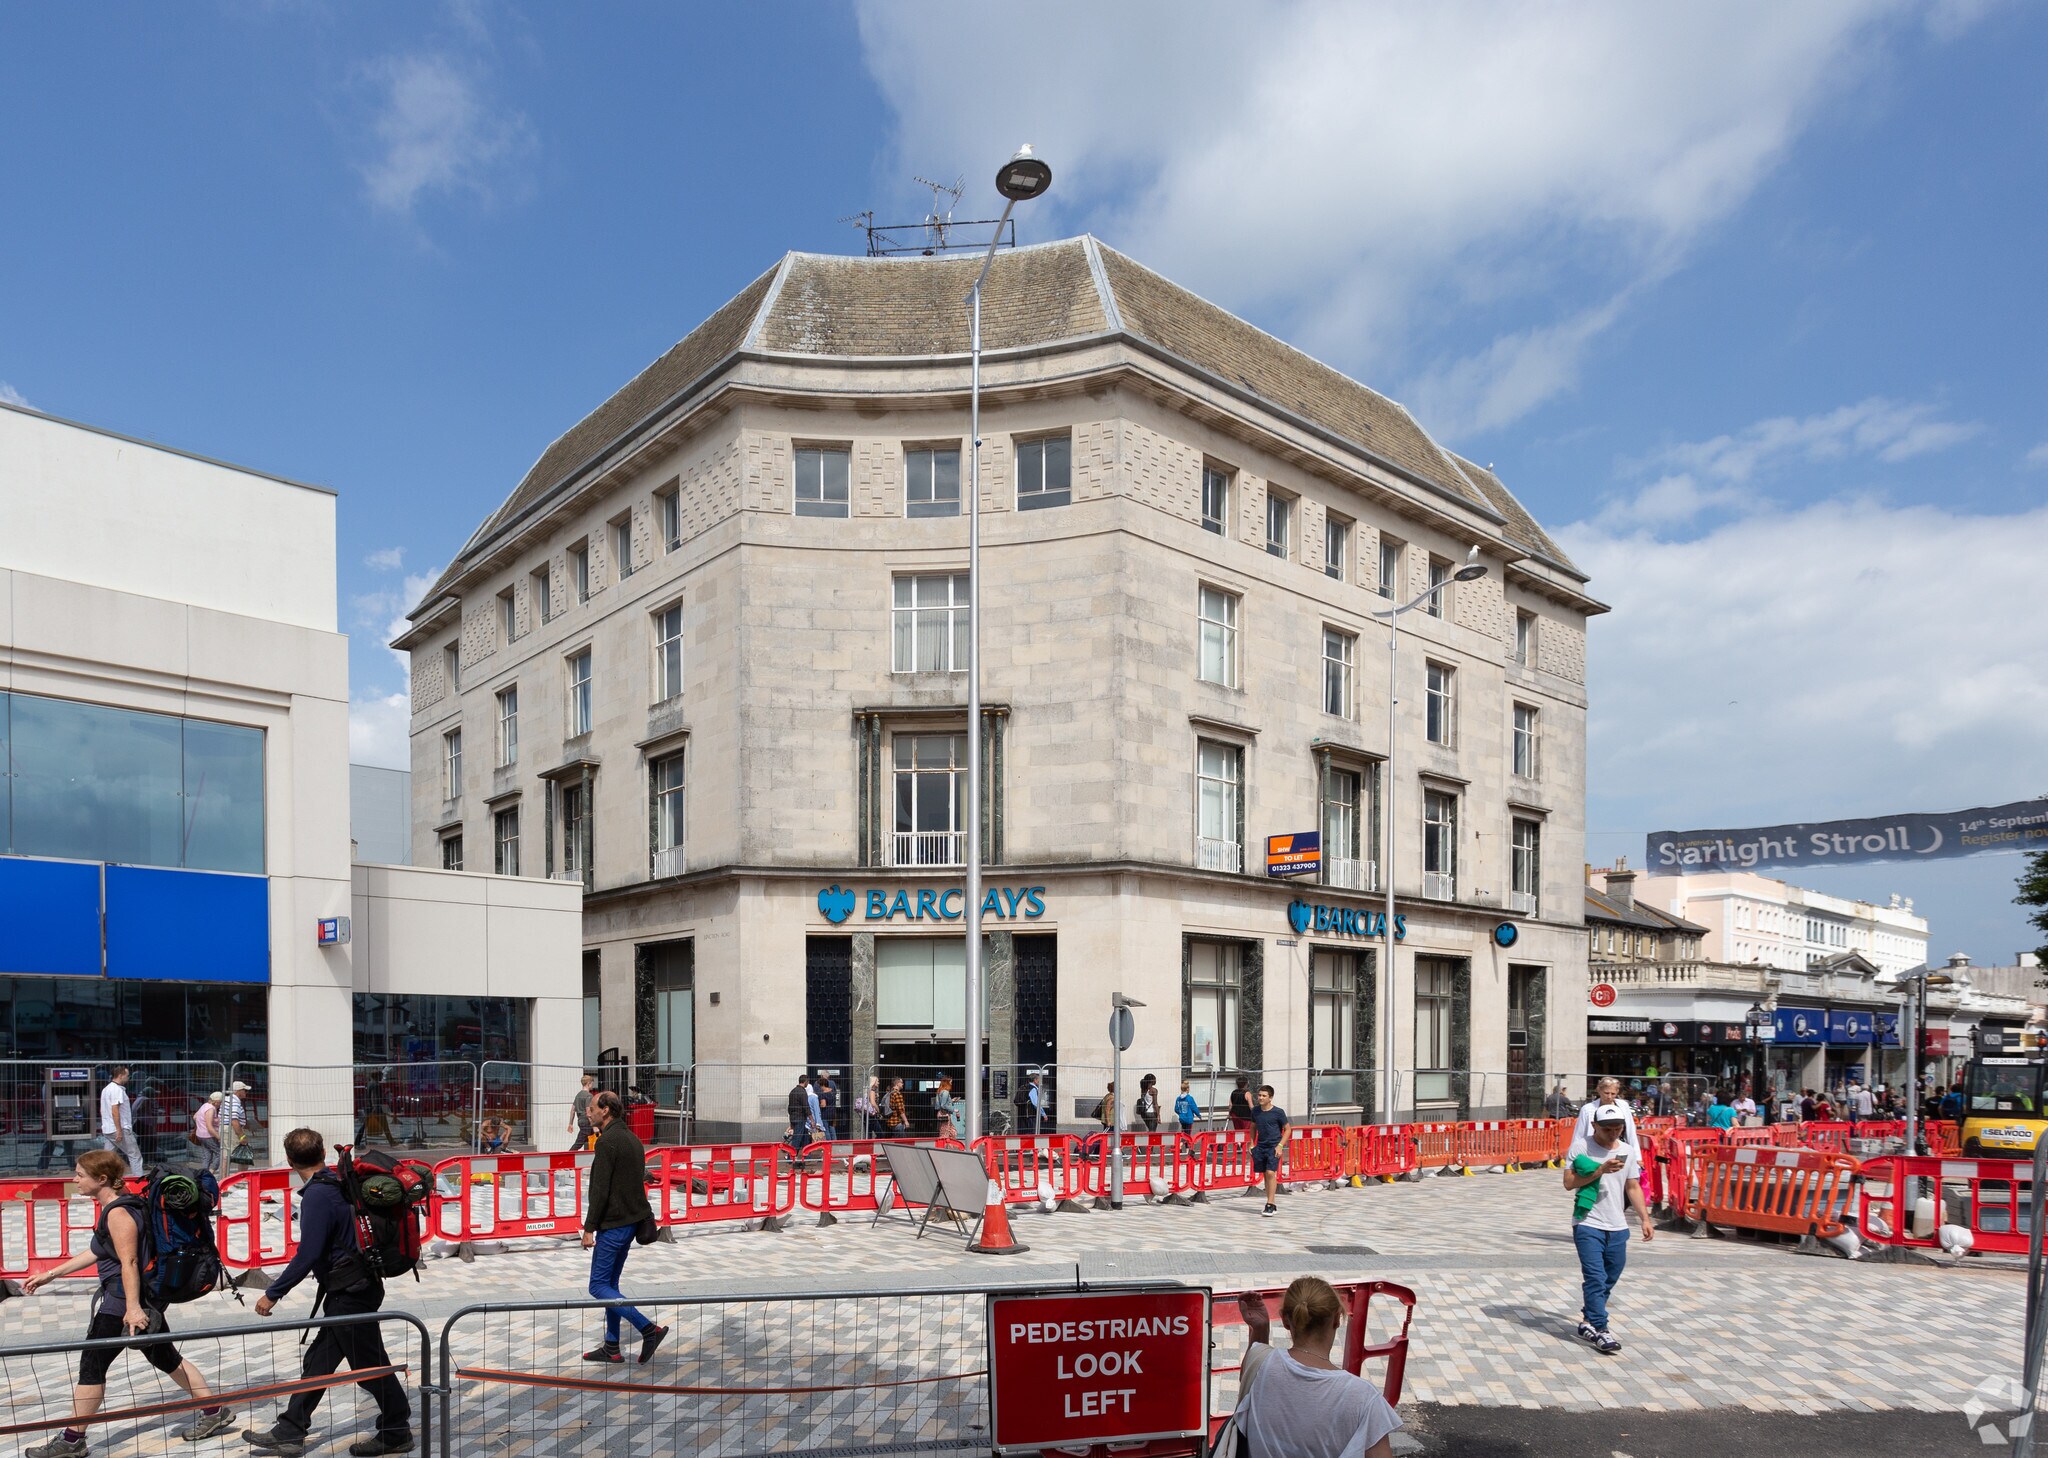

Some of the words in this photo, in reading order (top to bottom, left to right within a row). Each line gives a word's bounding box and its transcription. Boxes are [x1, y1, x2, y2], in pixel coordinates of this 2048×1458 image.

[1659, 836, 1798, 867] Starlight
[1810, 826, 1910, 856] Stroll
[1961, 831, 2019, 846] Register
[1271, 864, 1291, 872] 01323
[1292, 862, 1316, 870] 437900
[865, 886, 1046, 920] BARCAYS
[1987, 1128, 2032, 1137] SELWOOD
[526, 1222, 554, 1230] MILDREN
[1010, 1316, 1189, 1344] PEDESTRIANS
[1057, 1350, 1143, 1380] LOOK
[1064, 1389, 1136, 1418] LEFT
